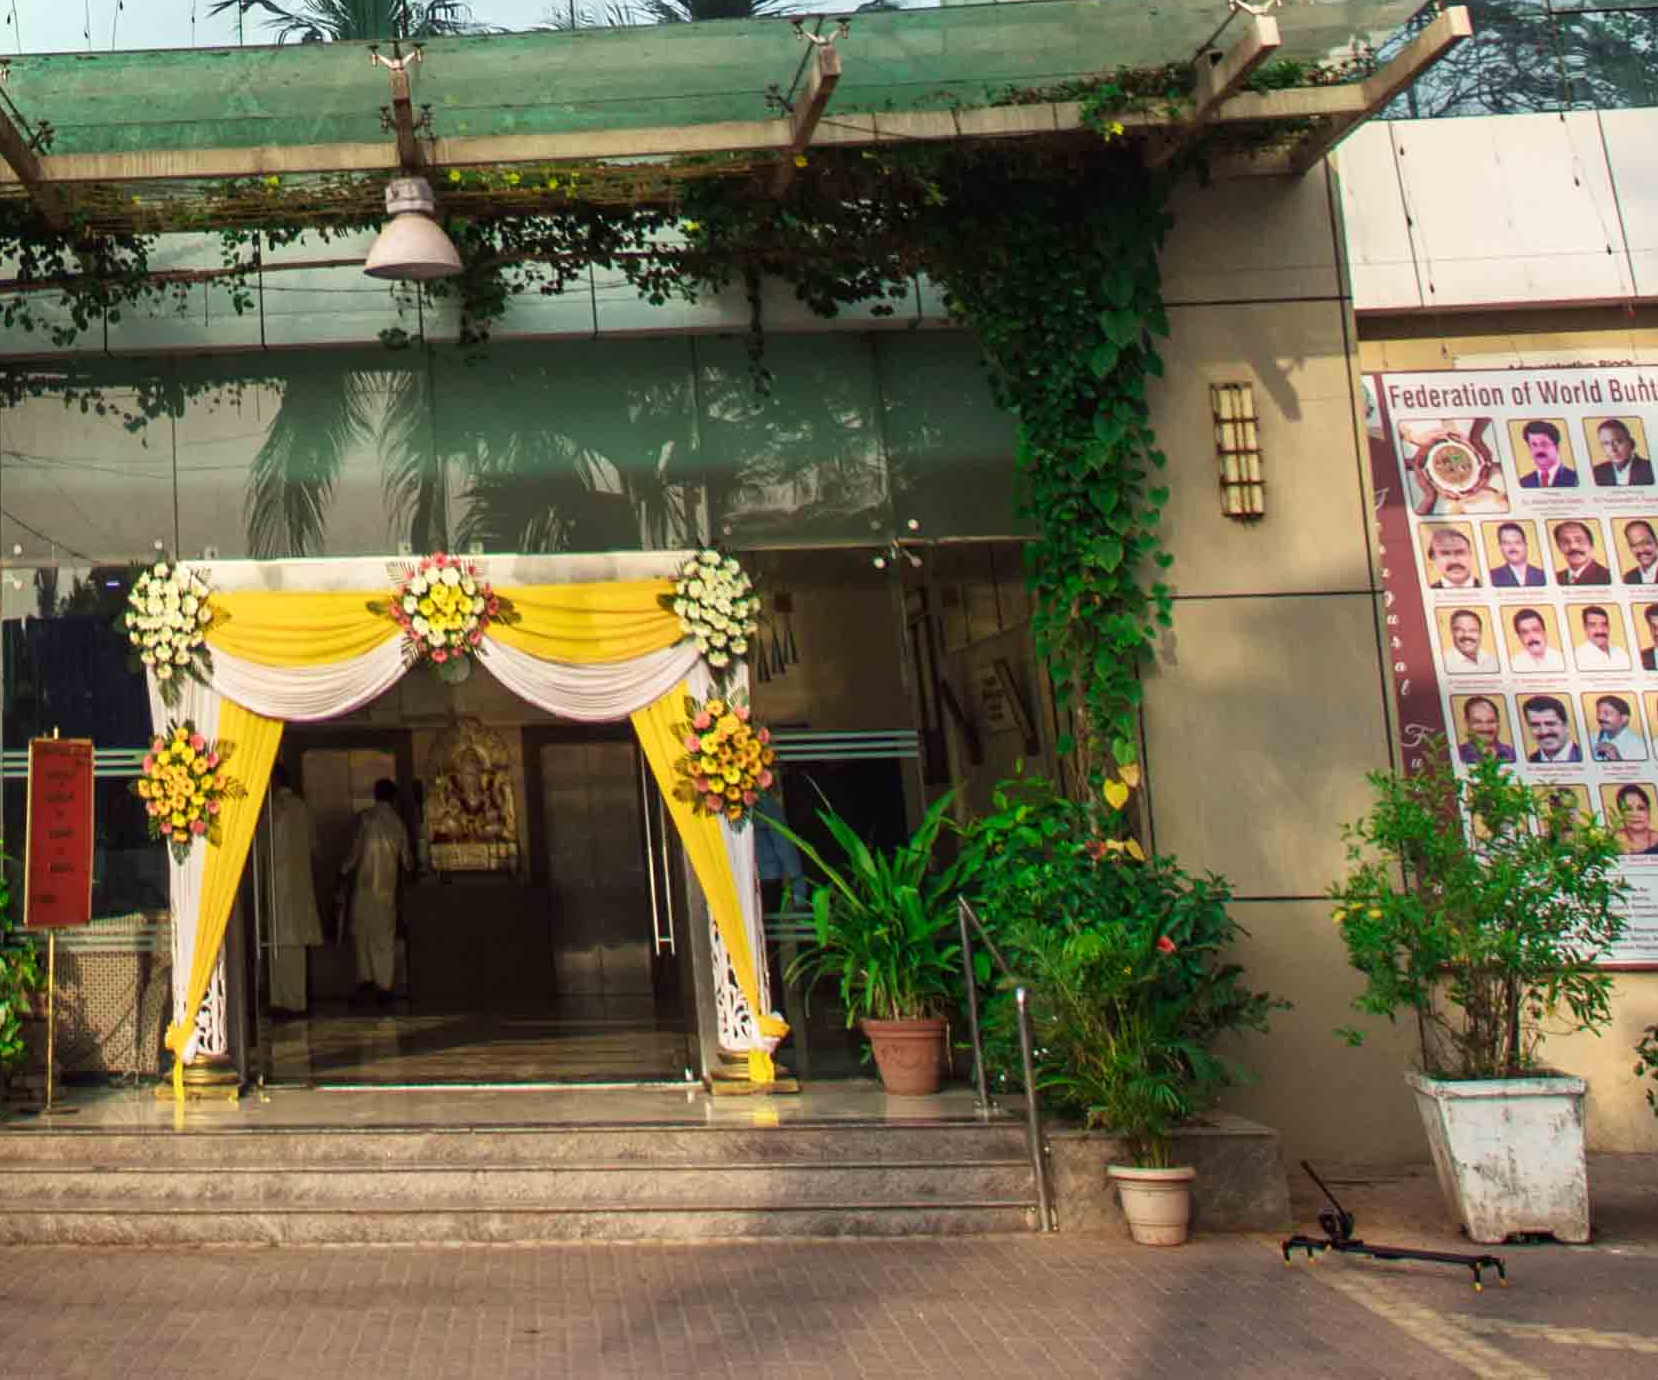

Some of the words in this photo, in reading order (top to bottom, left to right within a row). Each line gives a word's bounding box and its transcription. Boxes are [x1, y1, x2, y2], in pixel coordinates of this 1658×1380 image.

[1388, 380, 1505, 409] Federation
[1511, 379, 1532, 406] of
[1536, 377, 1604, 405] World
